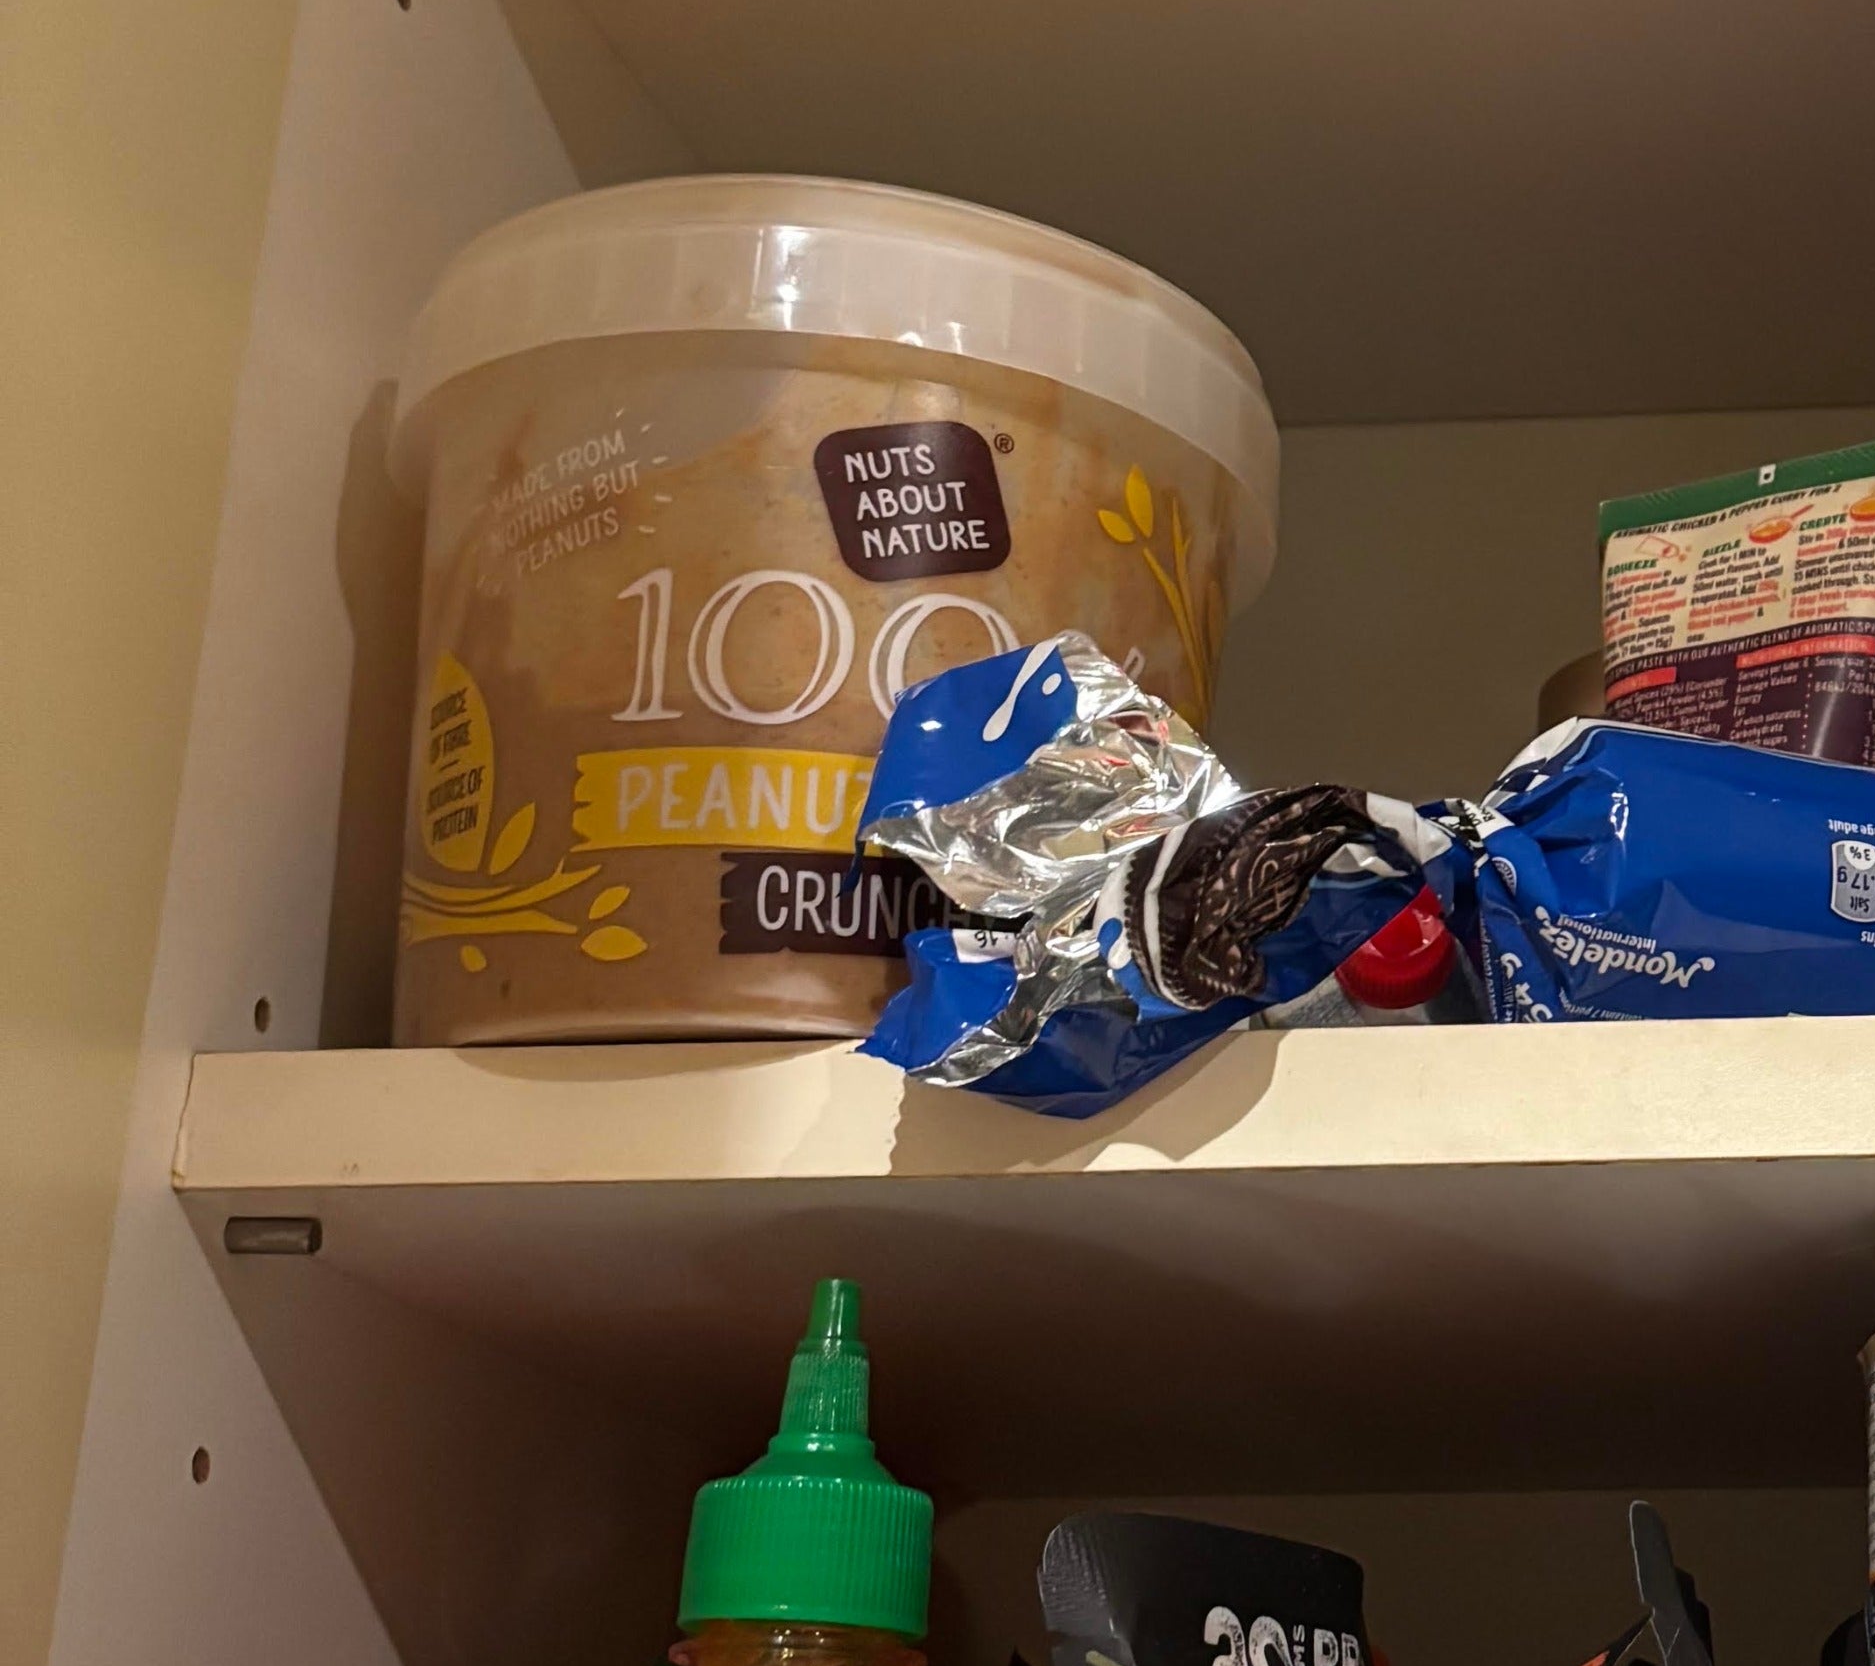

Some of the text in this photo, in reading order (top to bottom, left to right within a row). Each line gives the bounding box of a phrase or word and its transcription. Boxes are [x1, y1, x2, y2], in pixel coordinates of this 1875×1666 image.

[558, 429, 626, 478] FROM
[845, 445, 934, 484] NUTS
[593, 460, 639, 502] BUT
[857, 484, 966, 519] ABOUT
[515, 506, 619, 577] PEANUTS
[861, 520, 989, 559] NATURE
[611, 568, 1022, 727] 100
[618, 767, 870, 837] PEANU
[1828, 819, 1858, 834] adult
[1849, 897, 1870, 912] Salt
[1557, 914, 1657, 954] International
